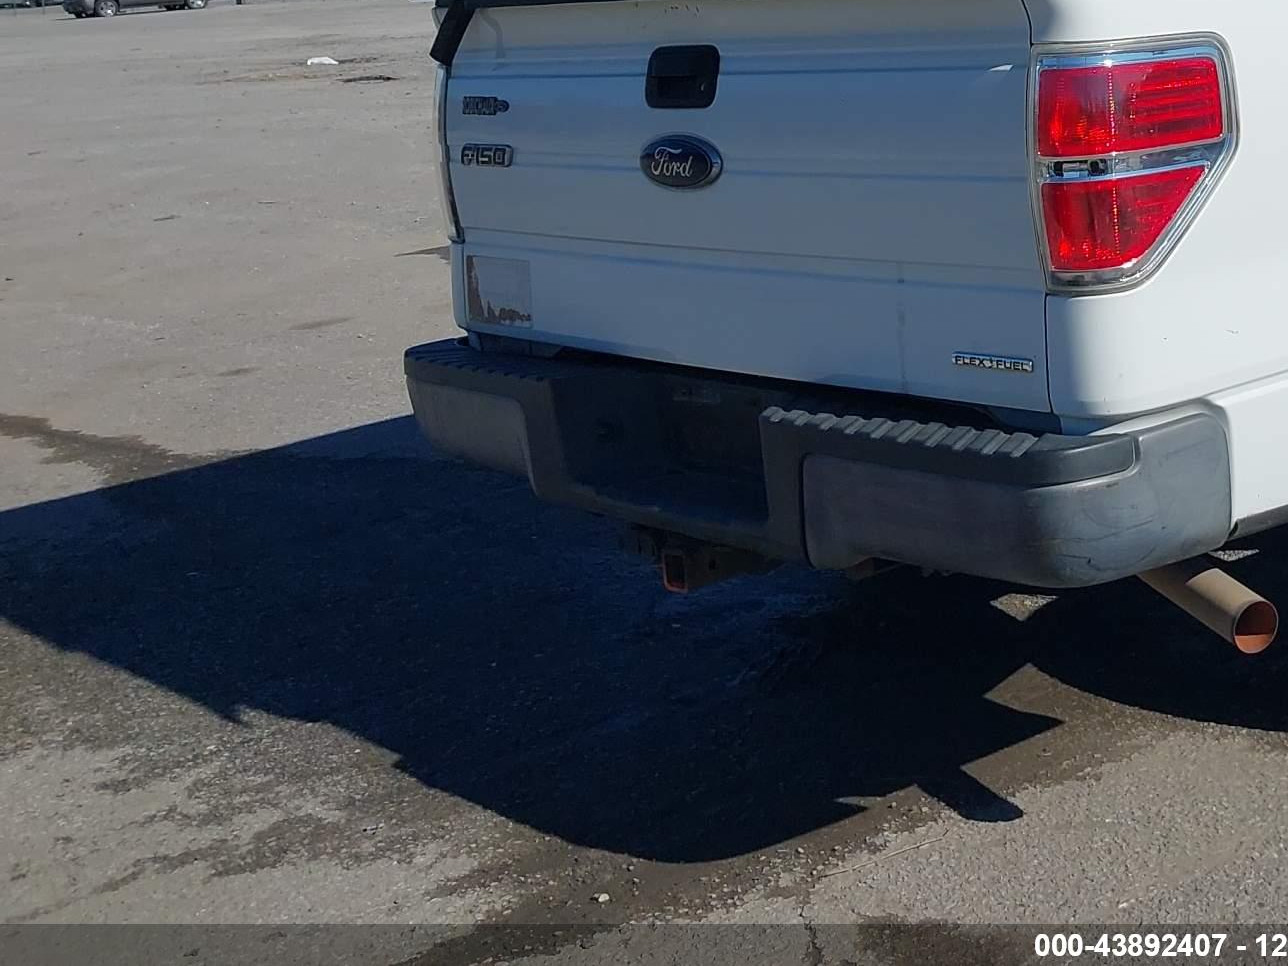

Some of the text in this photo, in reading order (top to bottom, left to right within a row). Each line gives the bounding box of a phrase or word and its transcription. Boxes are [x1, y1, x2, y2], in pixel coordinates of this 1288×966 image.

[651, 146, 694, 177] Ford
[954, 354, 1030, 372] FLEX FUEL
